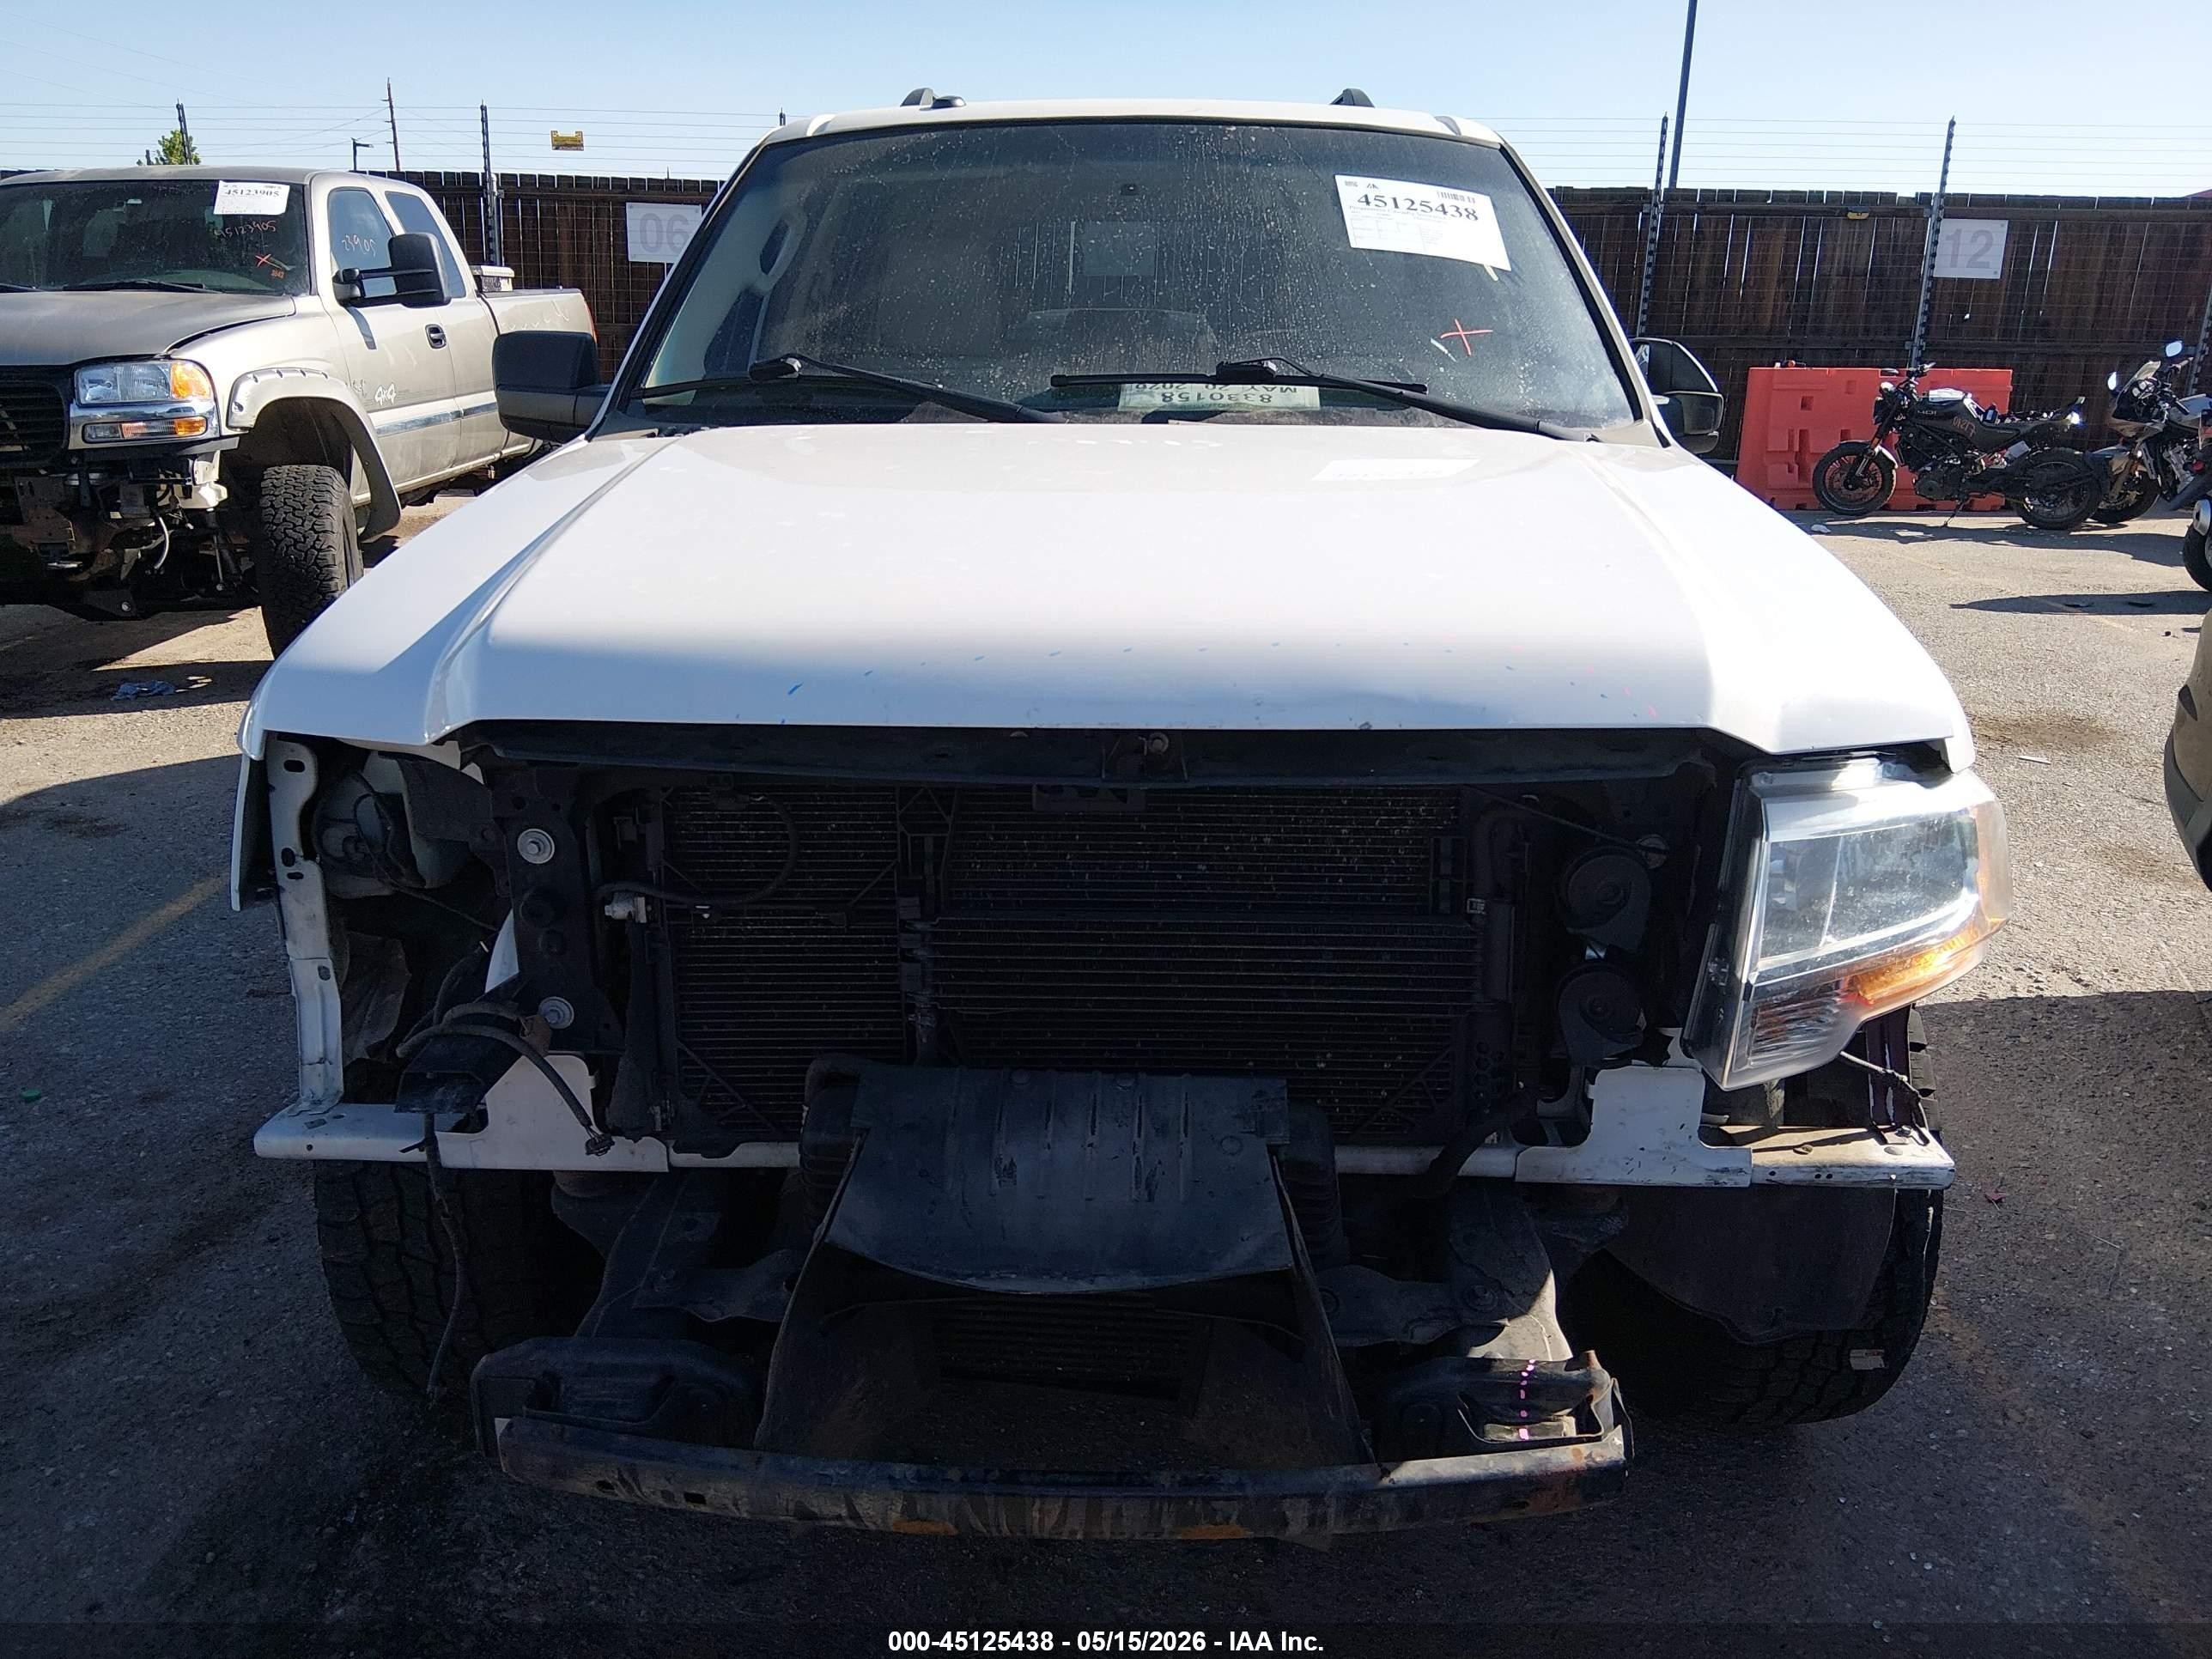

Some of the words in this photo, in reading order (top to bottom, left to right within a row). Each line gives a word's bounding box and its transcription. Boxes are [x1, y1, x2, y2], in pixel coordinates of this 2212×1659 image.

[224, 188, 280, 197] 45123905
[1357, 193, 1479, 221] 45125438
[215, 220, 276, 238] 45123905
[639, 213, 689, 253] 06
[1945, 228, 1994, 268] 12
[1161, 392, 1273, 404] 8330158
